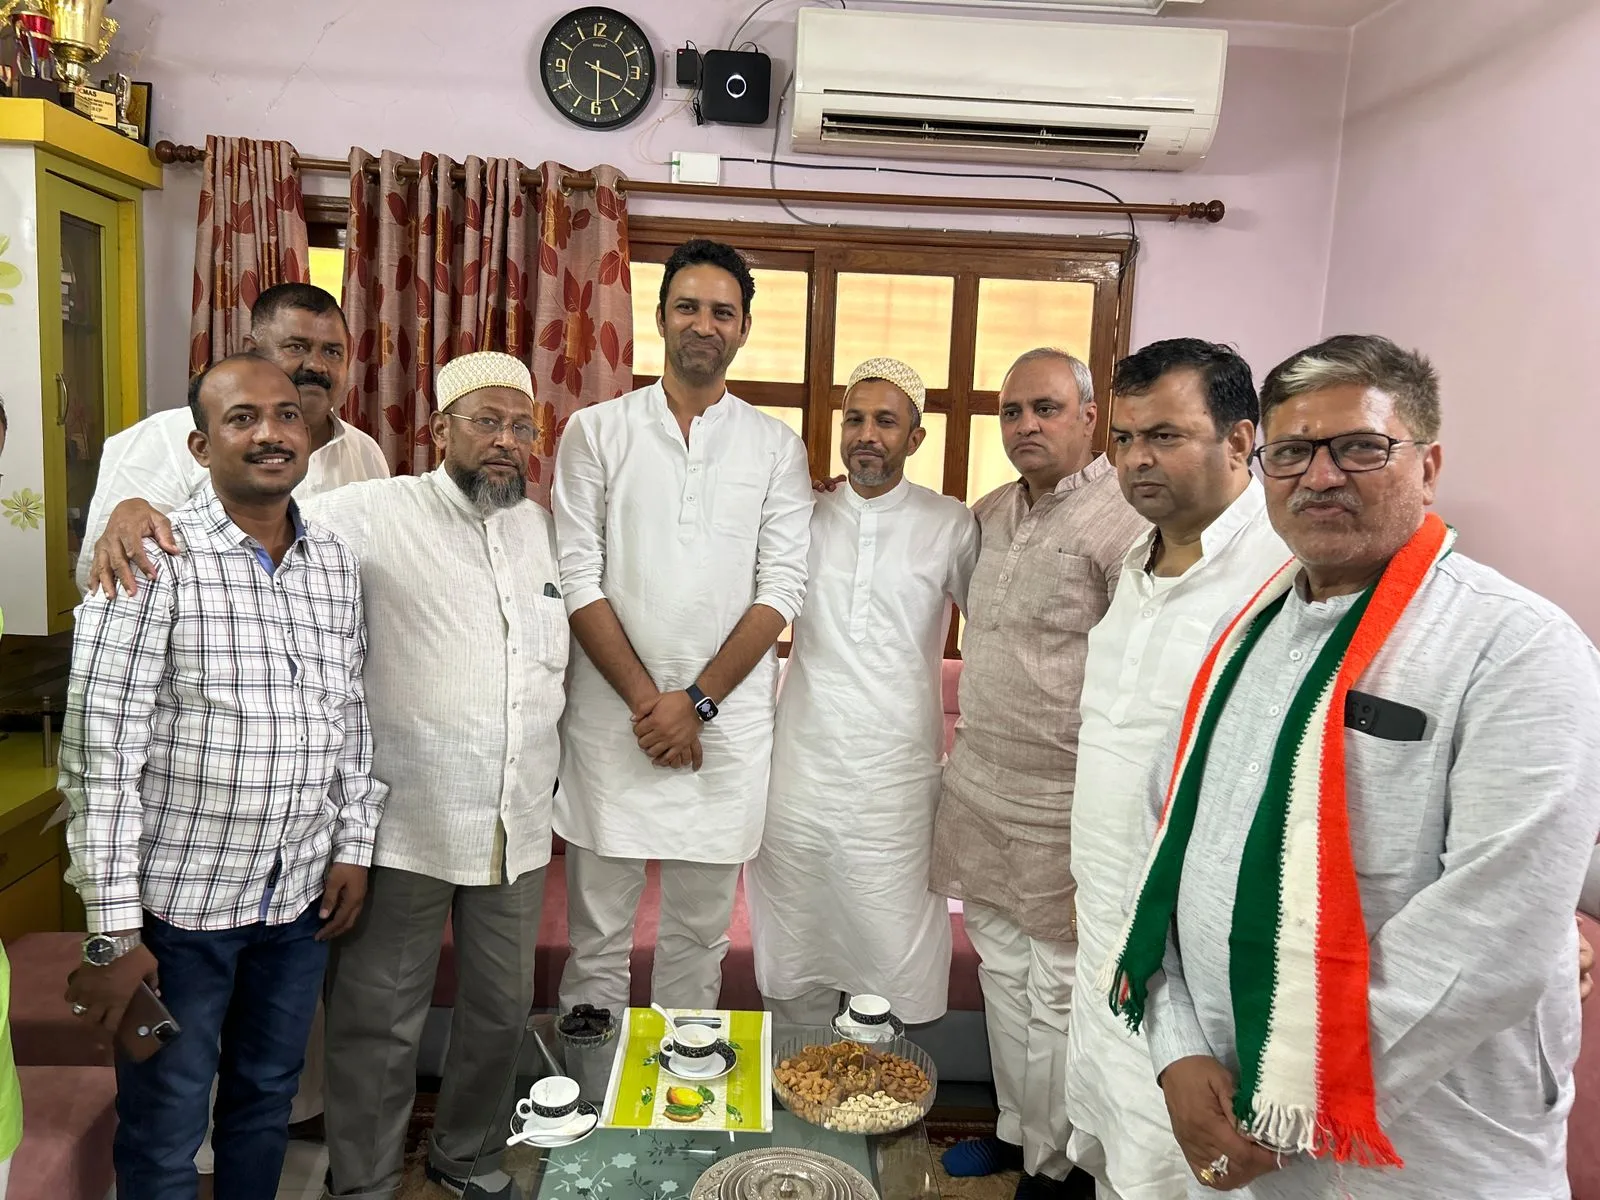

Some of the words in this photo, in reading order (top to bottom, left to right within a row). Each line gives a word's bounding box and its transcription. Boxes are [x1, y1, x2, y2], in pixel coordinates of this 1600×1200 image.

[593, 23, 607, 37] 12
[555, 58, 566, 73] 9
[630, 65, 641, 80] 3
[590, 101, 602, 115] 6
